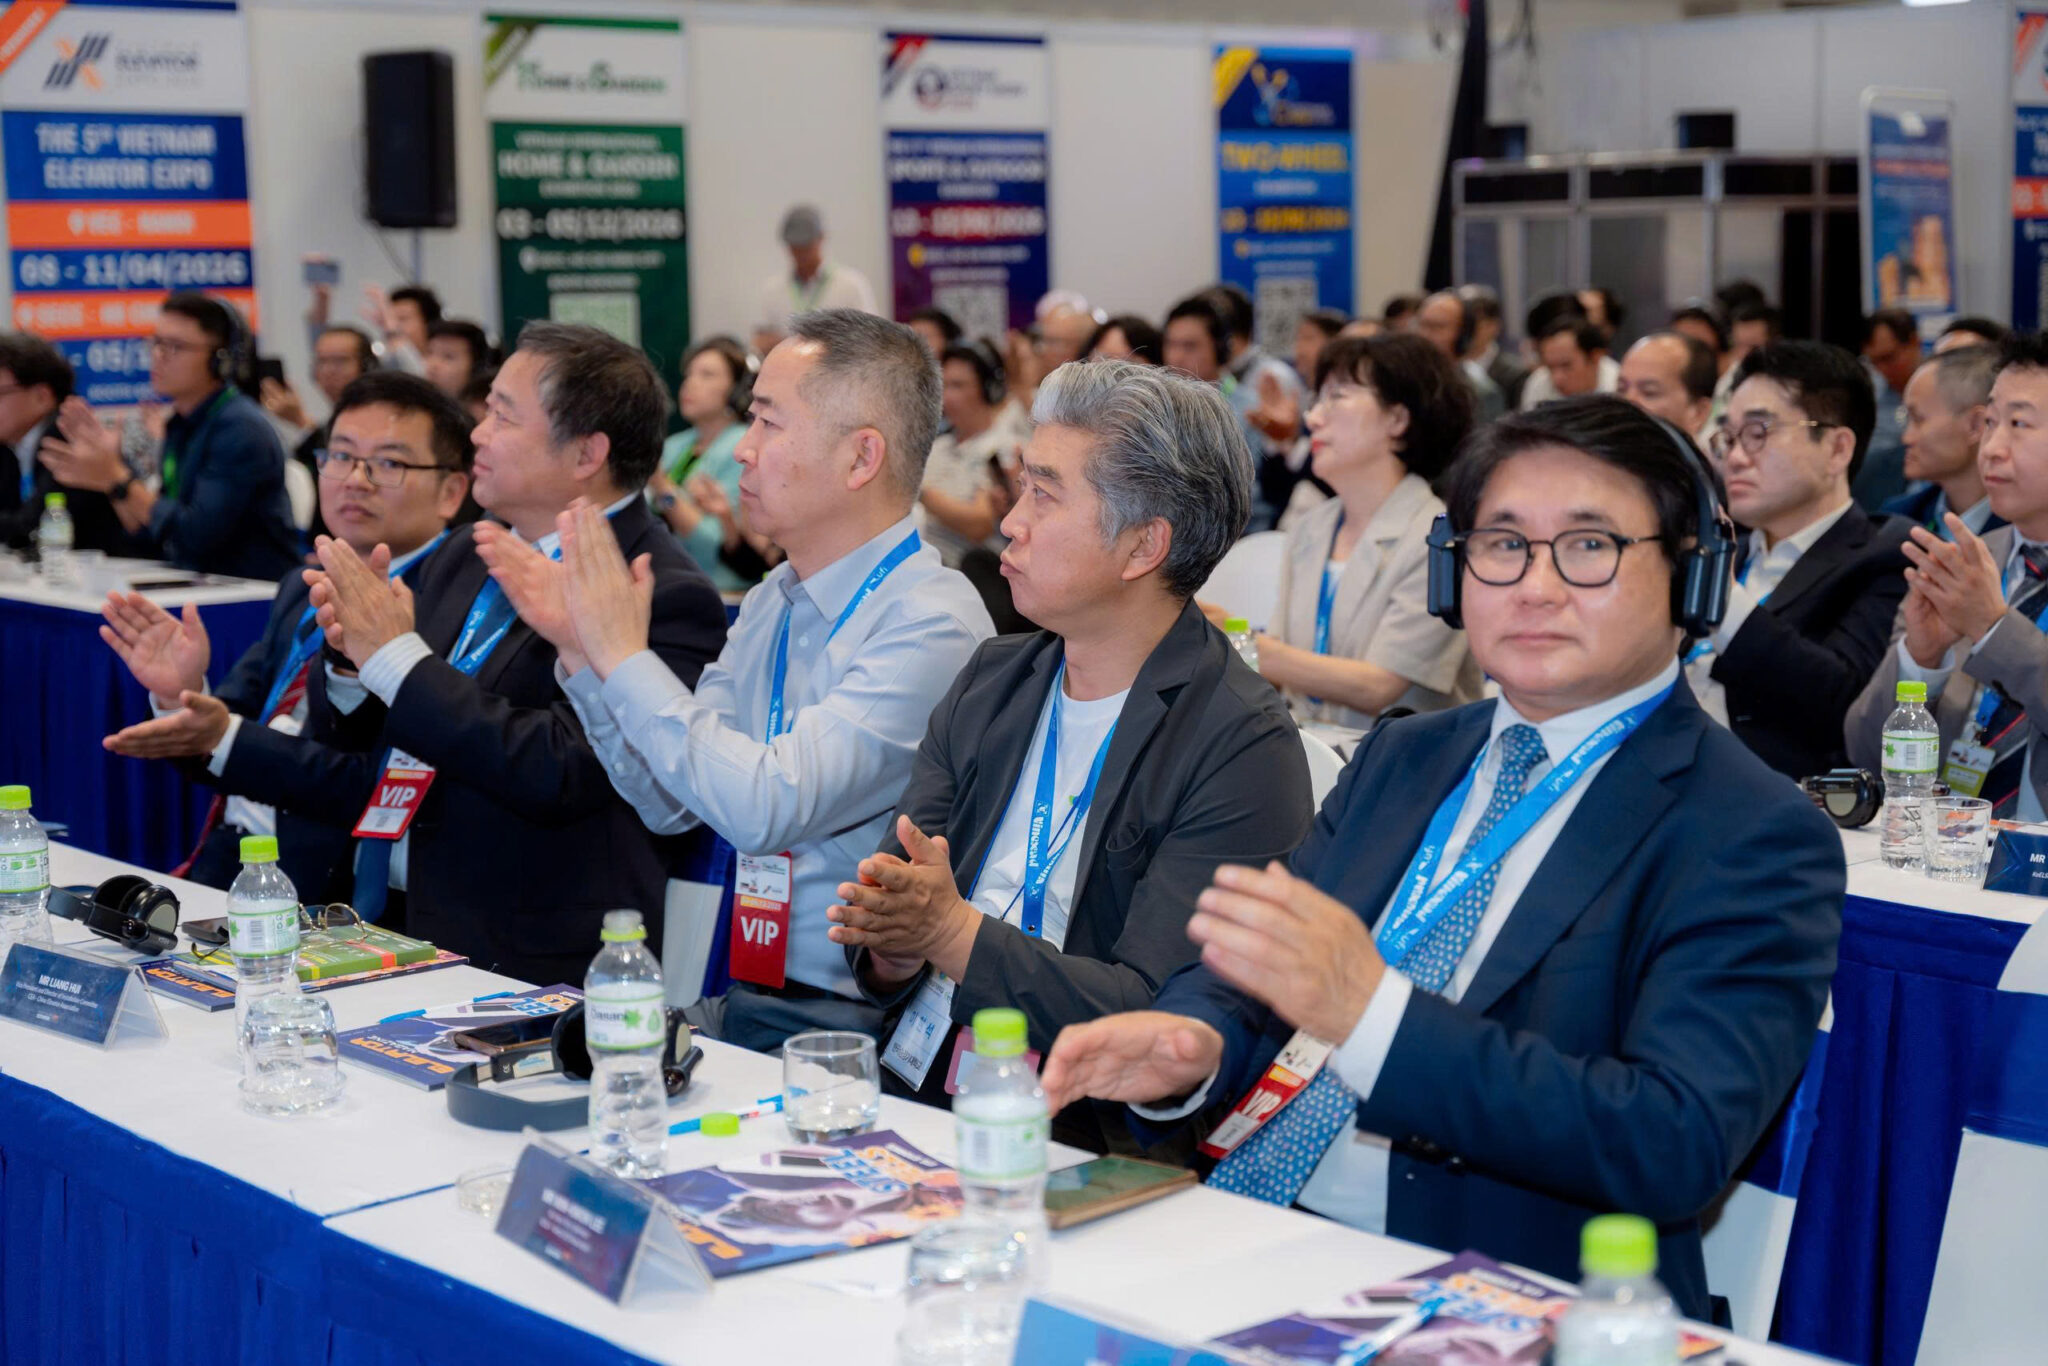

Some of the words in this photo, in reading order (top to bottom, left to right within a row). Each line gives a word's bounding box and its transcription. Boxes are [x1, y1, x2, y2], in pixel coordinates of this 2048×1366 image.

[37, 123, 78, 153] THE
[117, 125, 216, 155] VIETNAM
[44, 158, 148, 188] ELEVATOR
[152, 159, 212, 189] EXPO
[380, 785, 417, 807] VIP
[1028, 816, 1044, 868] Vinexad
[2030, 853, 2046, 864] MR
[740, 916, 779, 946] VIP
[38, 974, 51, 986] MR
[50, 977, 70, 991] LIANG
[69, 981, 82, 994] HUI
[1240, 1087, 1282, 1119] VIP
